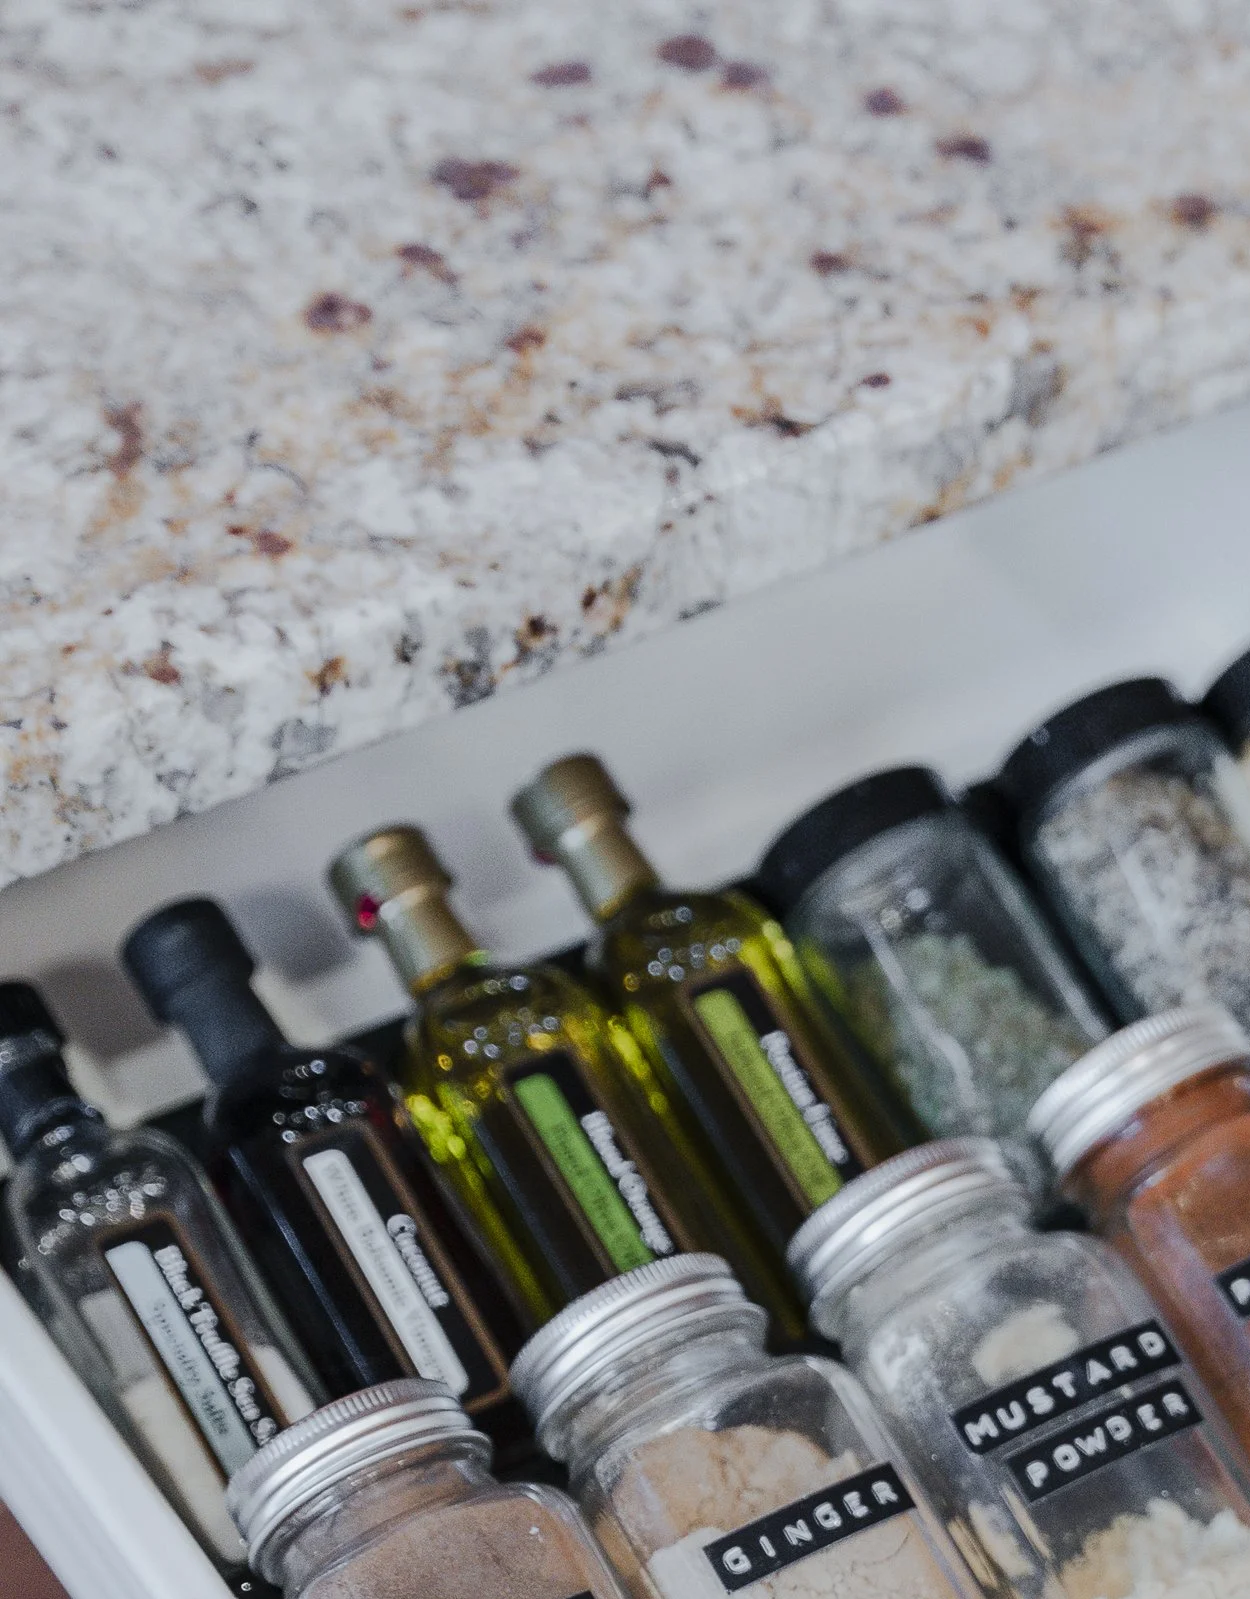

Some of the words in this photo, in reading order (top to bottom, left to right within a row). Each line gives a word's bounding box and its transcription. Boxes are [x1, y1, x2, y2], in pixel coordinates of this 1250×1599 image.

[964, 1331, 1167, 1446] MUSTARD
[1025, 1392, 1189, 1488] POWDER
[721, 1479, 899, 1575] GINGER
